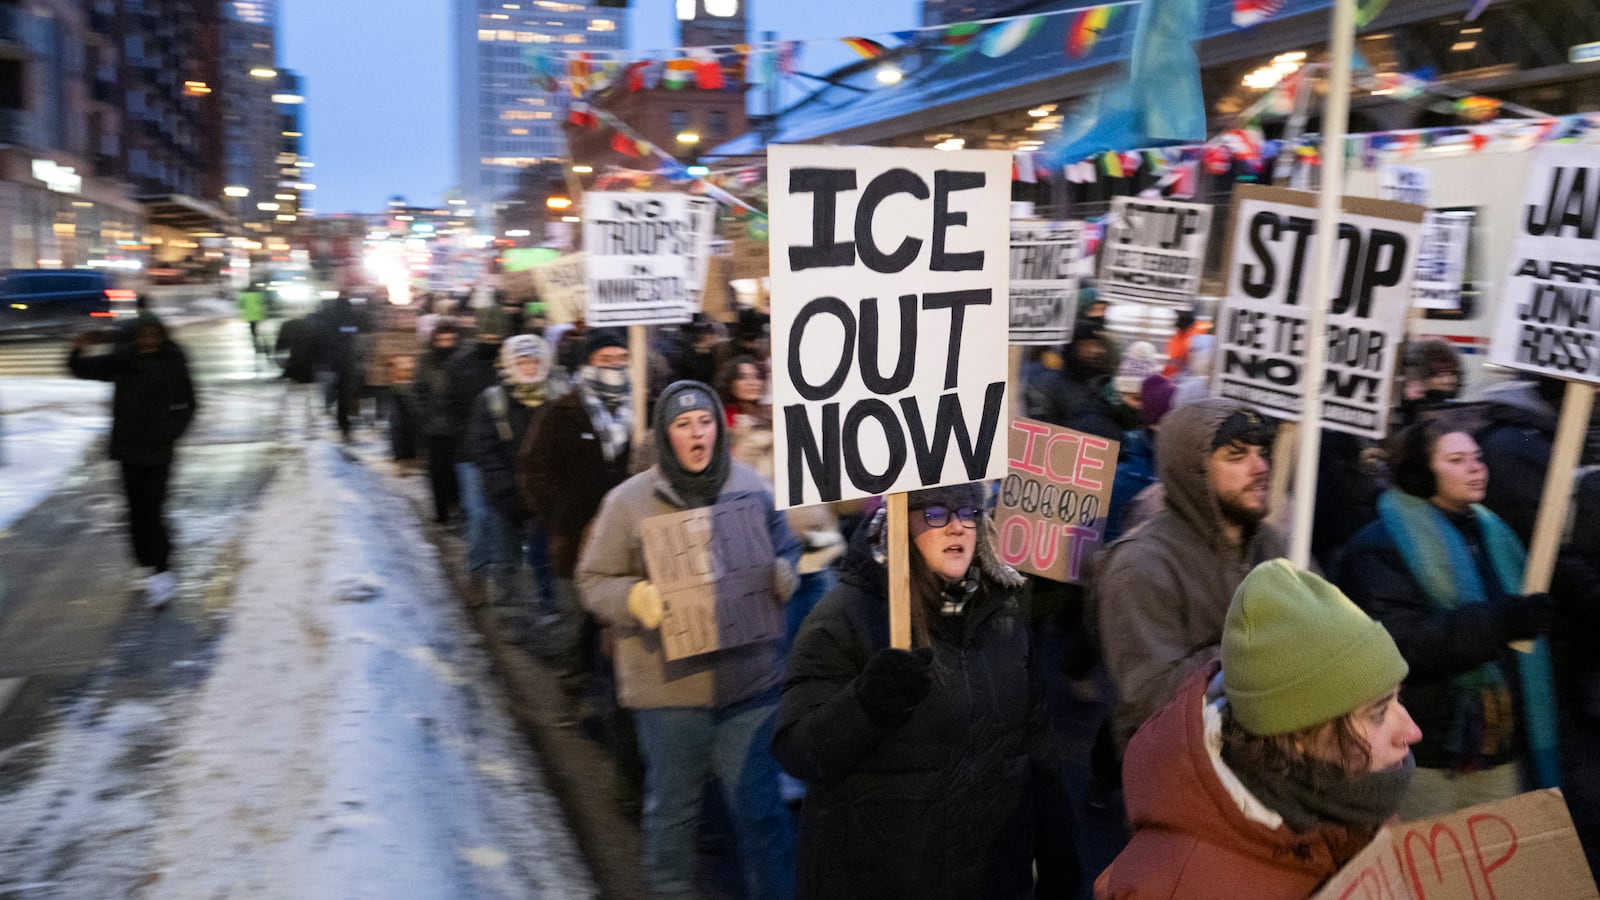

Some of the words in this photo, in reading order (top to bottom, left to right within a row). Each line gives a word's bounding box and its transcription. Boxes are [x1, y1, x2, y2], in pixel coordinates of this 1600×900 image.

[614, 199, 664, 219] NO
[788, 167, 986, 274] ICE
[1116, 202, 1203, 249] STOP
[1524, 166, 1600, 240] JA
[592, 219, 692, 256] TROOPS
[1009, 244, 1078, 280] TRIKE
[1241, 210, 1408, 319] STOP
[1510, 258, 1600, 287] ARR
[1518, 282, 1600, 331] JONA
[787, 288, 992, 401] OUT
[1228, 308, 1267, 349] ICE
[1272, 314, 1386, 372] TEROR
[1515, 322, 1594, 374] ROSS
[783, 381, 1006, 506] NOW
[1008, 420, 1109, 490] ICE
[1000, 514, 1099, 581] OUT
[1337, 812, 1518, 900] UMP
